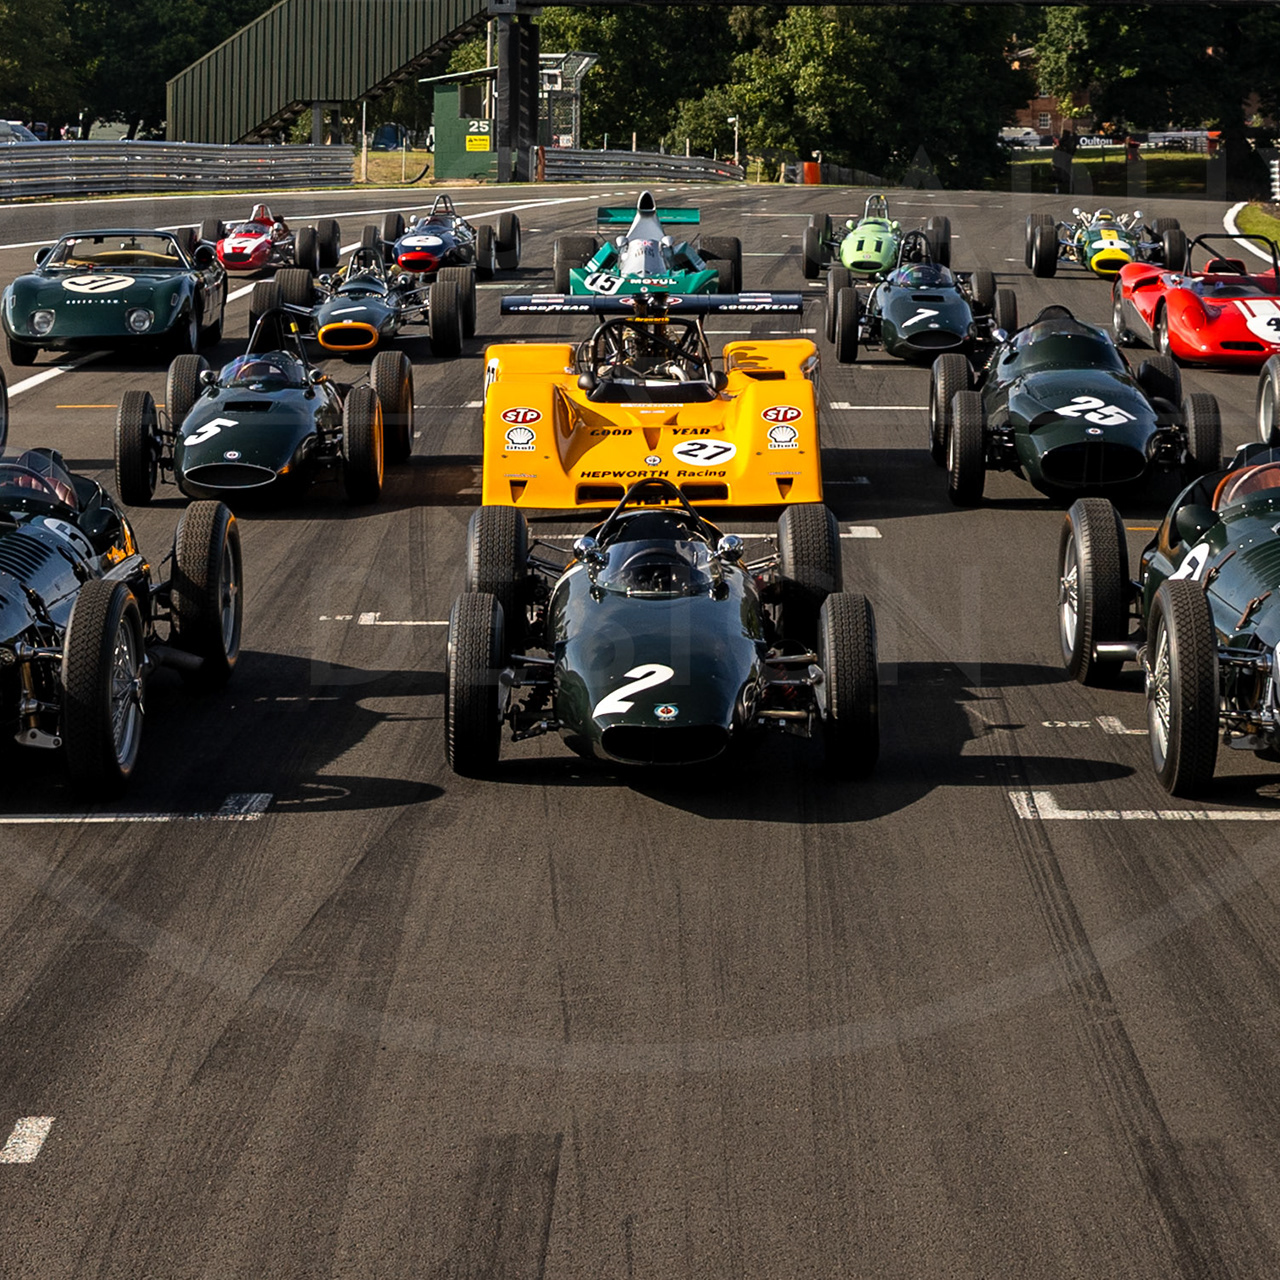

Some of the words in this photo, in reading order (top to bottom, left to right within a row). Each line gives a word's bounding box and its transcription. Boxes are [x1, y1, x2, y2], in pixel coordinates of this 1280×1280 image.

[468, 121, 489, 132] 25
[1079, 136, 1113, 146] Oulton
[856, 239, 883, 253] 11
[588, 274, 617, 292] 15
[509, 304, 589, 312] GOODYEAR
[718, 303, 799, 311] GOODYEAR
[901, 308, 939, 328] 7
[505, 408, 538, 422] STP
[765, 407, 799, 421] STP
[1054, 396, 1138, 426] 25
[184, 418, 239, 446] 5
[590, 429, 632, 437] GOOD
[672, 428, 710, 436] YEAR
[677, 442, 732, 461] 27
[580, 470, 669, 478] HEPWORTH
[677, 469, 727, 478] Racing
[591, 663, 674, 719] 2
